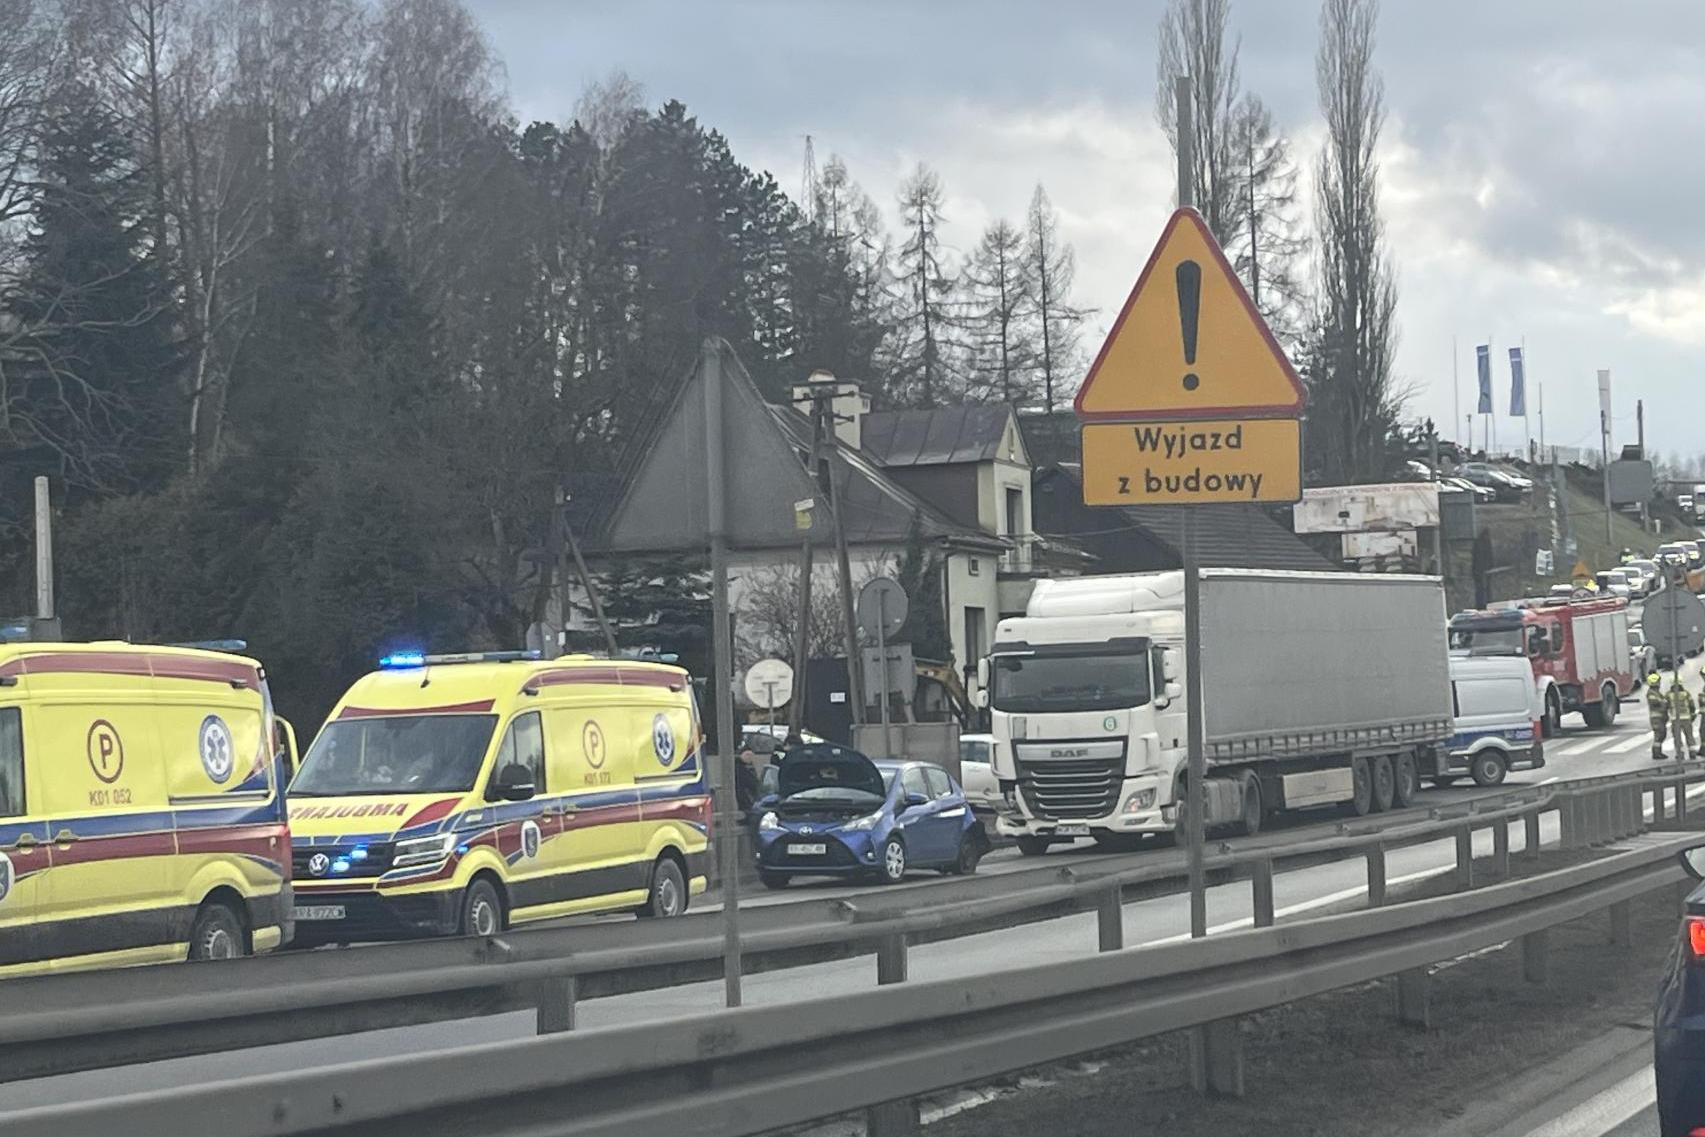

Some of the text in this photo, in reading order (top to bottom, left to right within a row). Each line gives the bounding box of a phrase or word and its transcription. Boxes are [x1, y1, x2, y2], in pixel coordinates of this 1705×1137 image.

[1134, 424, 1242, 459] Wyjazd
[1118, 467, 1262, 498] z budowy
[99, 733, 113, 769] P
[590, 731, 599, 758] P
[1051, 749, 1088, 758] DAF
